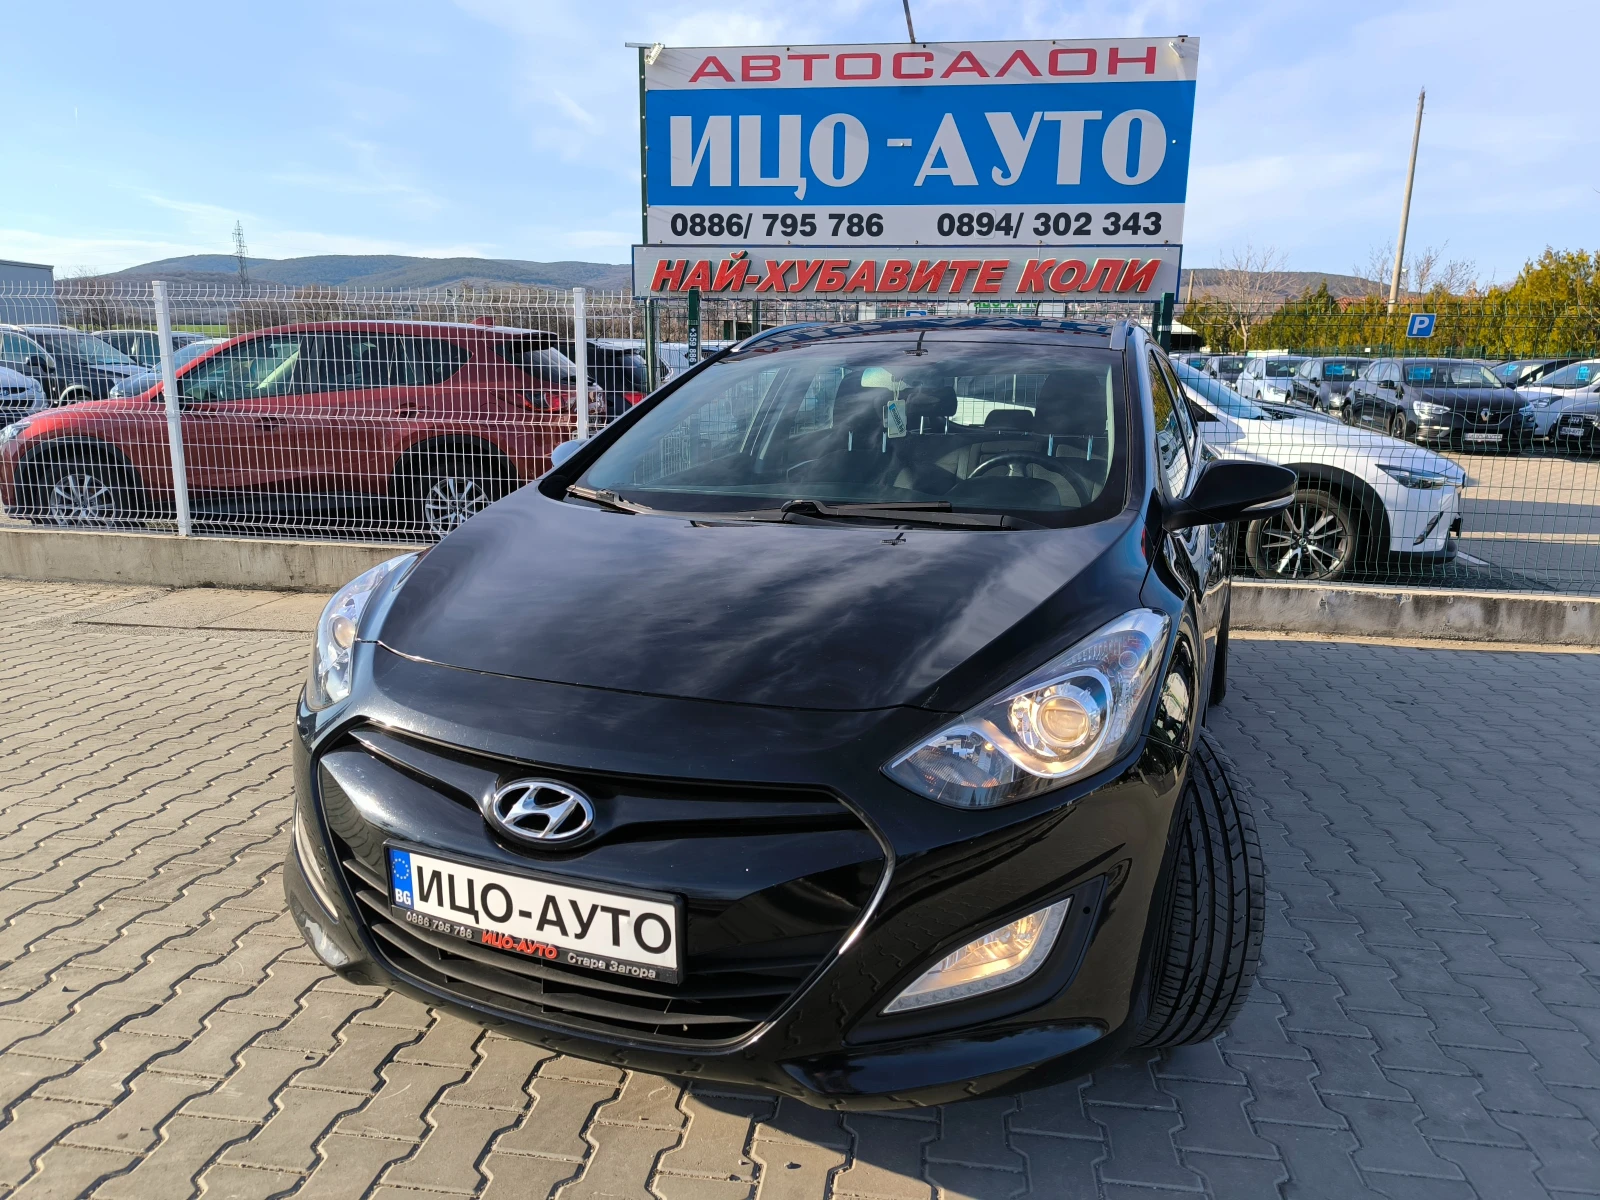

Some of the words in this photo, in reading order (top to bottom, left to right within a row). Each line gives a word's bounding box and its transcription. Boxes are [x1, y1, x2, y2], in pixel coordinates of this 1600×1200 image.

[689, 47, 1157, 82] АВТОСАЛОН
[671, 213, 753, 239] 0886/
[763, 213, 817, 237] 795
[829, 213, 884, 237] 786
[937, 212, 1024, 239] 0894/
[1034, 213, 1092, 237] 302
[1103, 211, 1162, 236] 343
[650, 250, 1010, 294] НАЙ-ХУБАВИТЕ
[1016, 258, 1162, 294] КОЛИ
[1413, 316, 1430, 335] P
[689, 348, 698, 363] 886
[395, 888, 411, 906] BG
[417, 866, 671, 954] ИЦО-АУТО
[406, 912, 430, 928] 0886
[432, 919, 451, 933] 795
[454, 926, 473, 940] 786
[482, 930, 557, 959] ИЦО-АУТО
[567, 952, 606, 970] Стара
[609, 960, 656, 978] Загора
